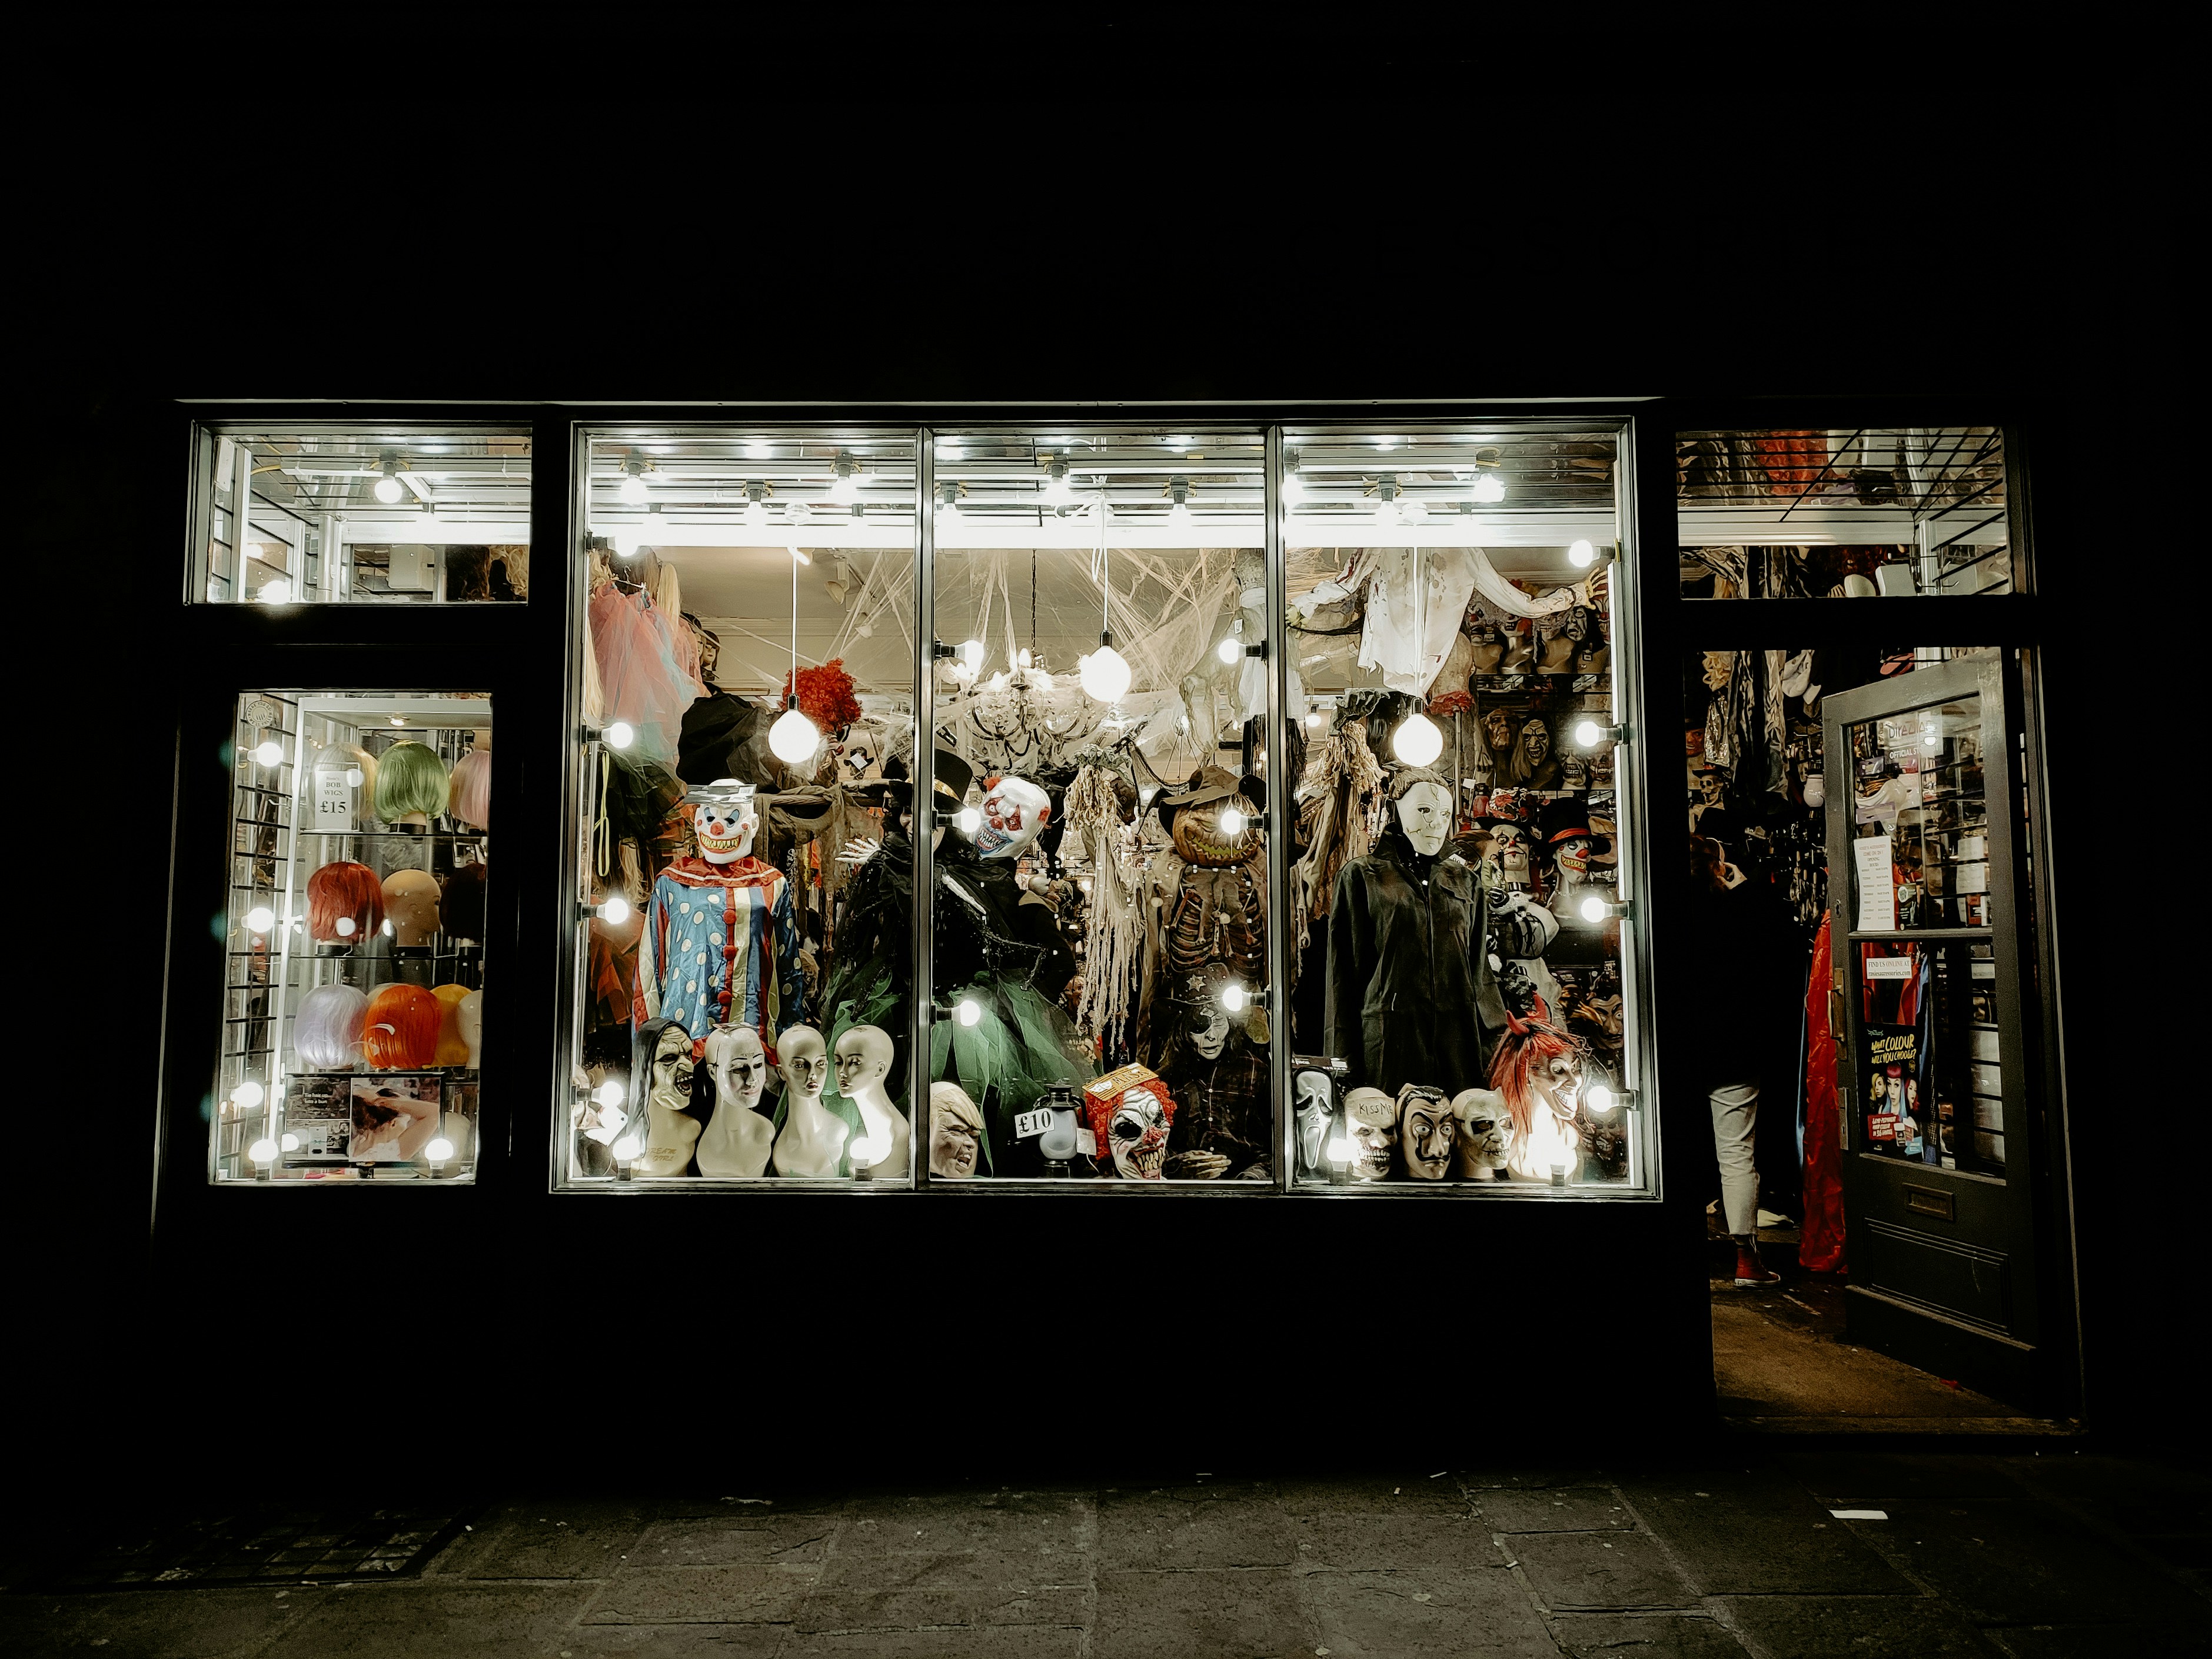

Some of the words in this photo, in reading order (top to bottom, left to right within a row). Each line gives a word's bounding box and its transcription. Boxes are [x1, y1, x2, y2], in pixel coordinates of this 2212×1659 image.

[1889, 748, 1912, 759] OFFICIAL
[320, 801, 346, 814] £15
[1885, 1034, 1914, 1051] COLOUR
[1871, 1054, 1882, 1064] WILL
[1882, 1052, 1894, 1064] YOU
[1894, 1048, 1917, 1060] CHOOSE?
[1359, 1103, 1379, 1115] KISS
[1380, 1102, 1393, 1115] ME
[1019, 1111, 1051, 1134] £10
